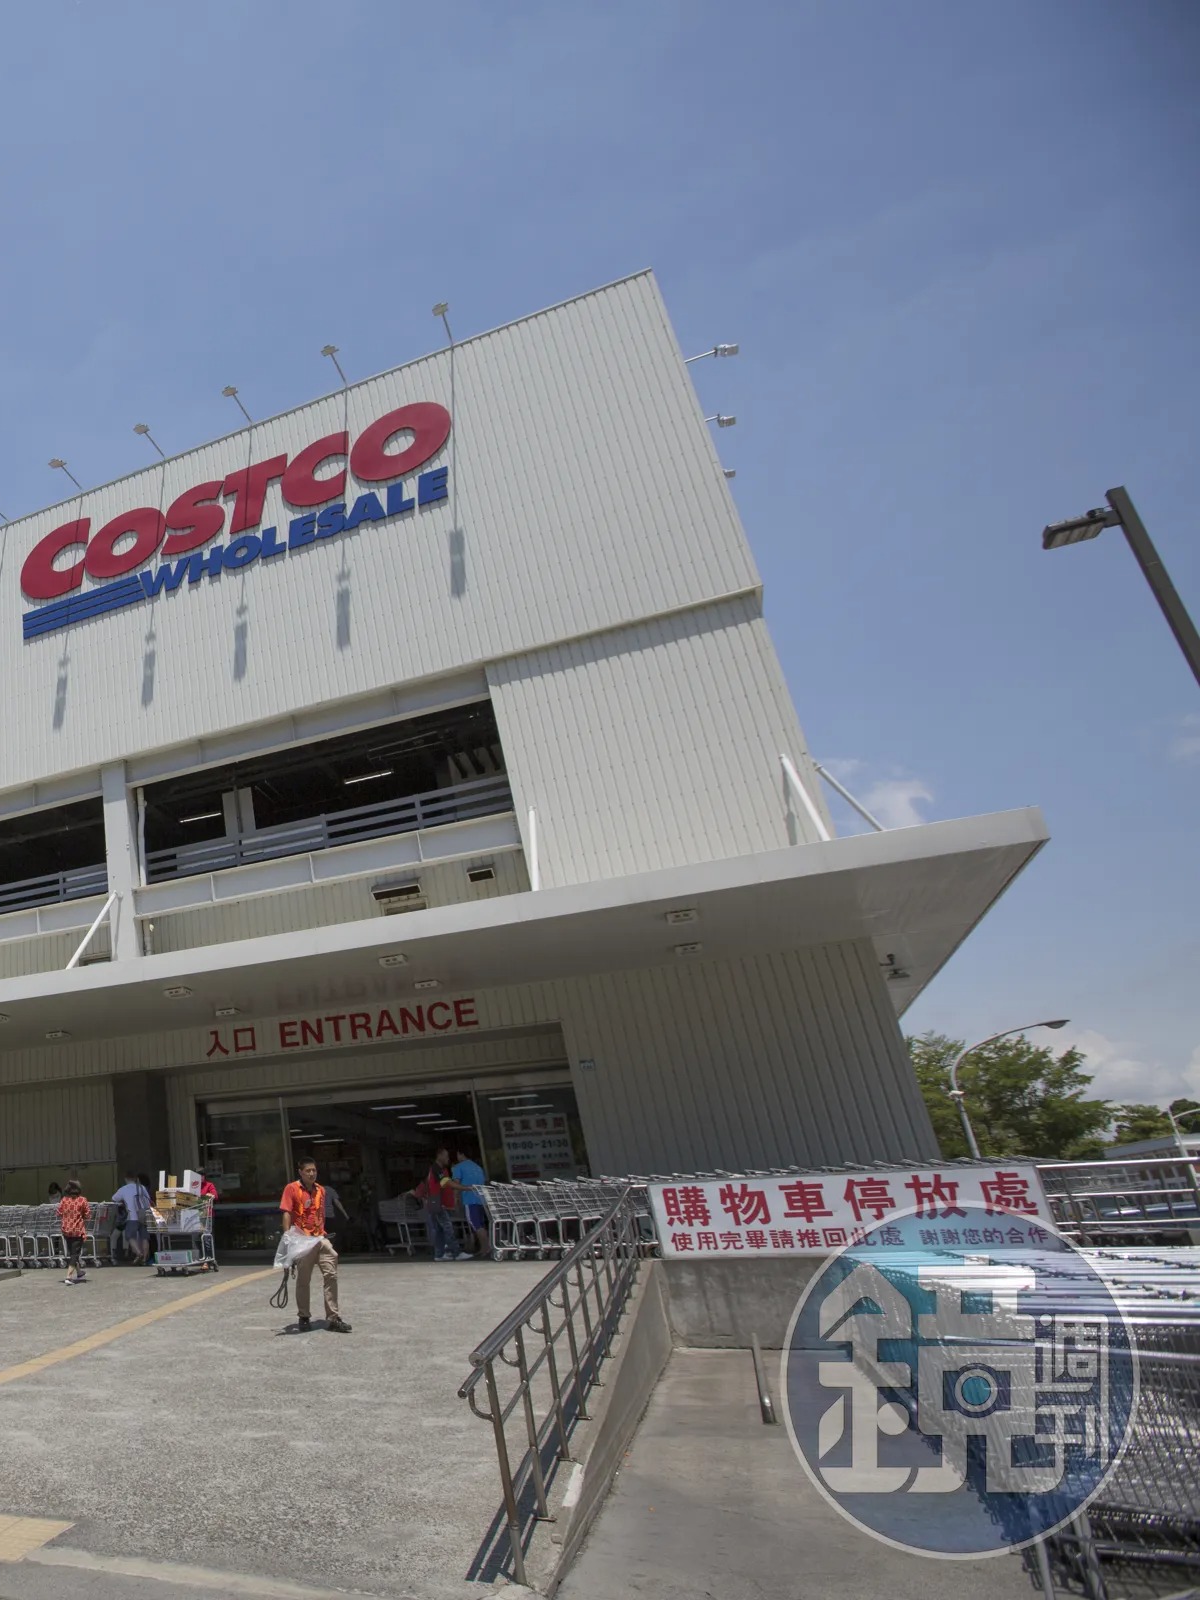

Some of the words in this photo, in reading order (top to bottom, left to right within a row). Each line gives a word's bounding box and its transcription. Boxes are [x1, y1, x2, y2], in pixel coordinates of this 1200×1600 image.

[20, 401, 451, 600] COSTCO
[139, 466, 449, 599] WHOLESALE
[206, 1027, 257, 1058] 入口
[278, 998, 480, 1048] ENTRANCE
[662, 1171, 1040, 1227] 購物車停放處
[670, 1226, 905, 1252] 使用完畢請推回此處
[921, 1225, 1050, 1247] 謝謝您的合作
